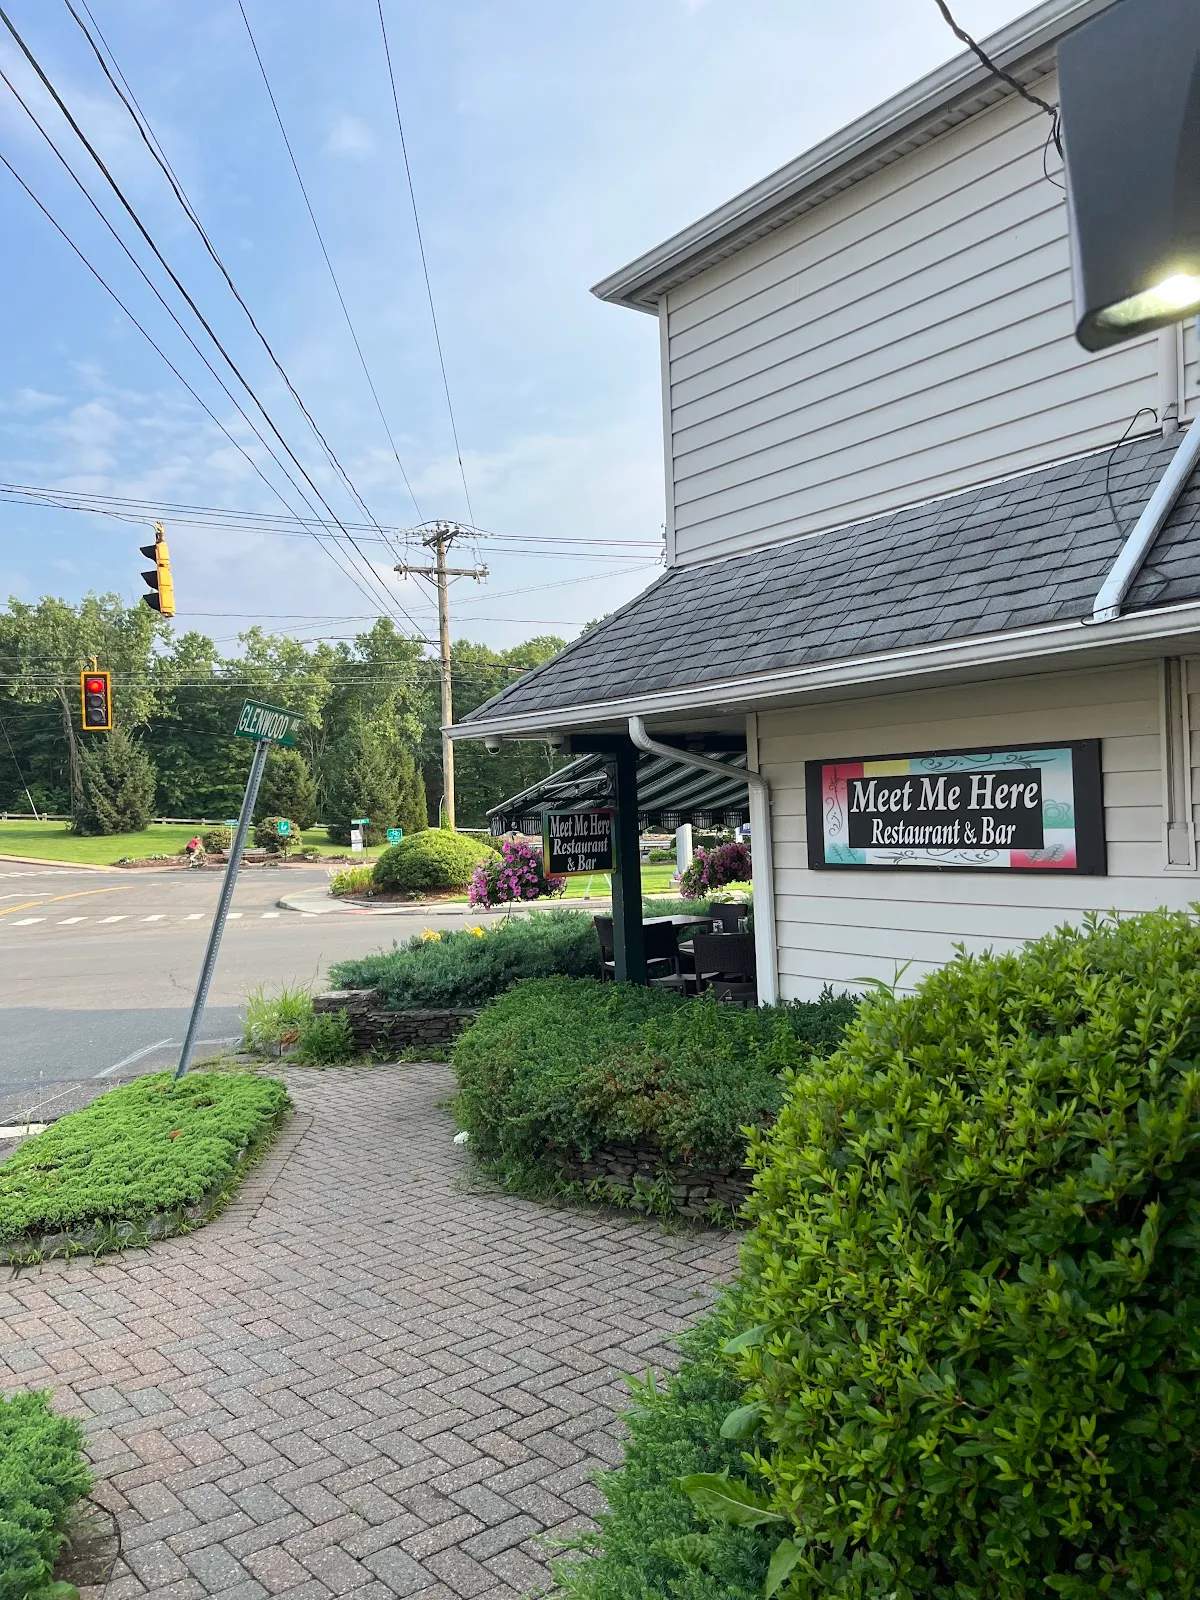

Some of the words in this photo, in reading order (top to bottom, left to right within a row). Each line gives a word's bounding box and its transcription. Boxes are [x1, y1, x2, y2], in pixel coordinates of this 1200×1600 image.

[239, 705, 289, 739] GLENWOOD
[850, 780, 913, 813] Meet
[917, 776, 961, 811] Me
[967, 774, 1039, 810] Here
[550, 815, 573, 838] Meet
[574, 814, 588, 836] Me
[590, 814, 610, 836] Here
[871, 818, 960, 844] Restaurant
[963, 820, 977, 844] &
[980, 816, 1016, 845] Bar
[553, 837, 608, 855] Restaurant
[567, 857, 576, 871] &
[577, 854, 596, 871] Bar
